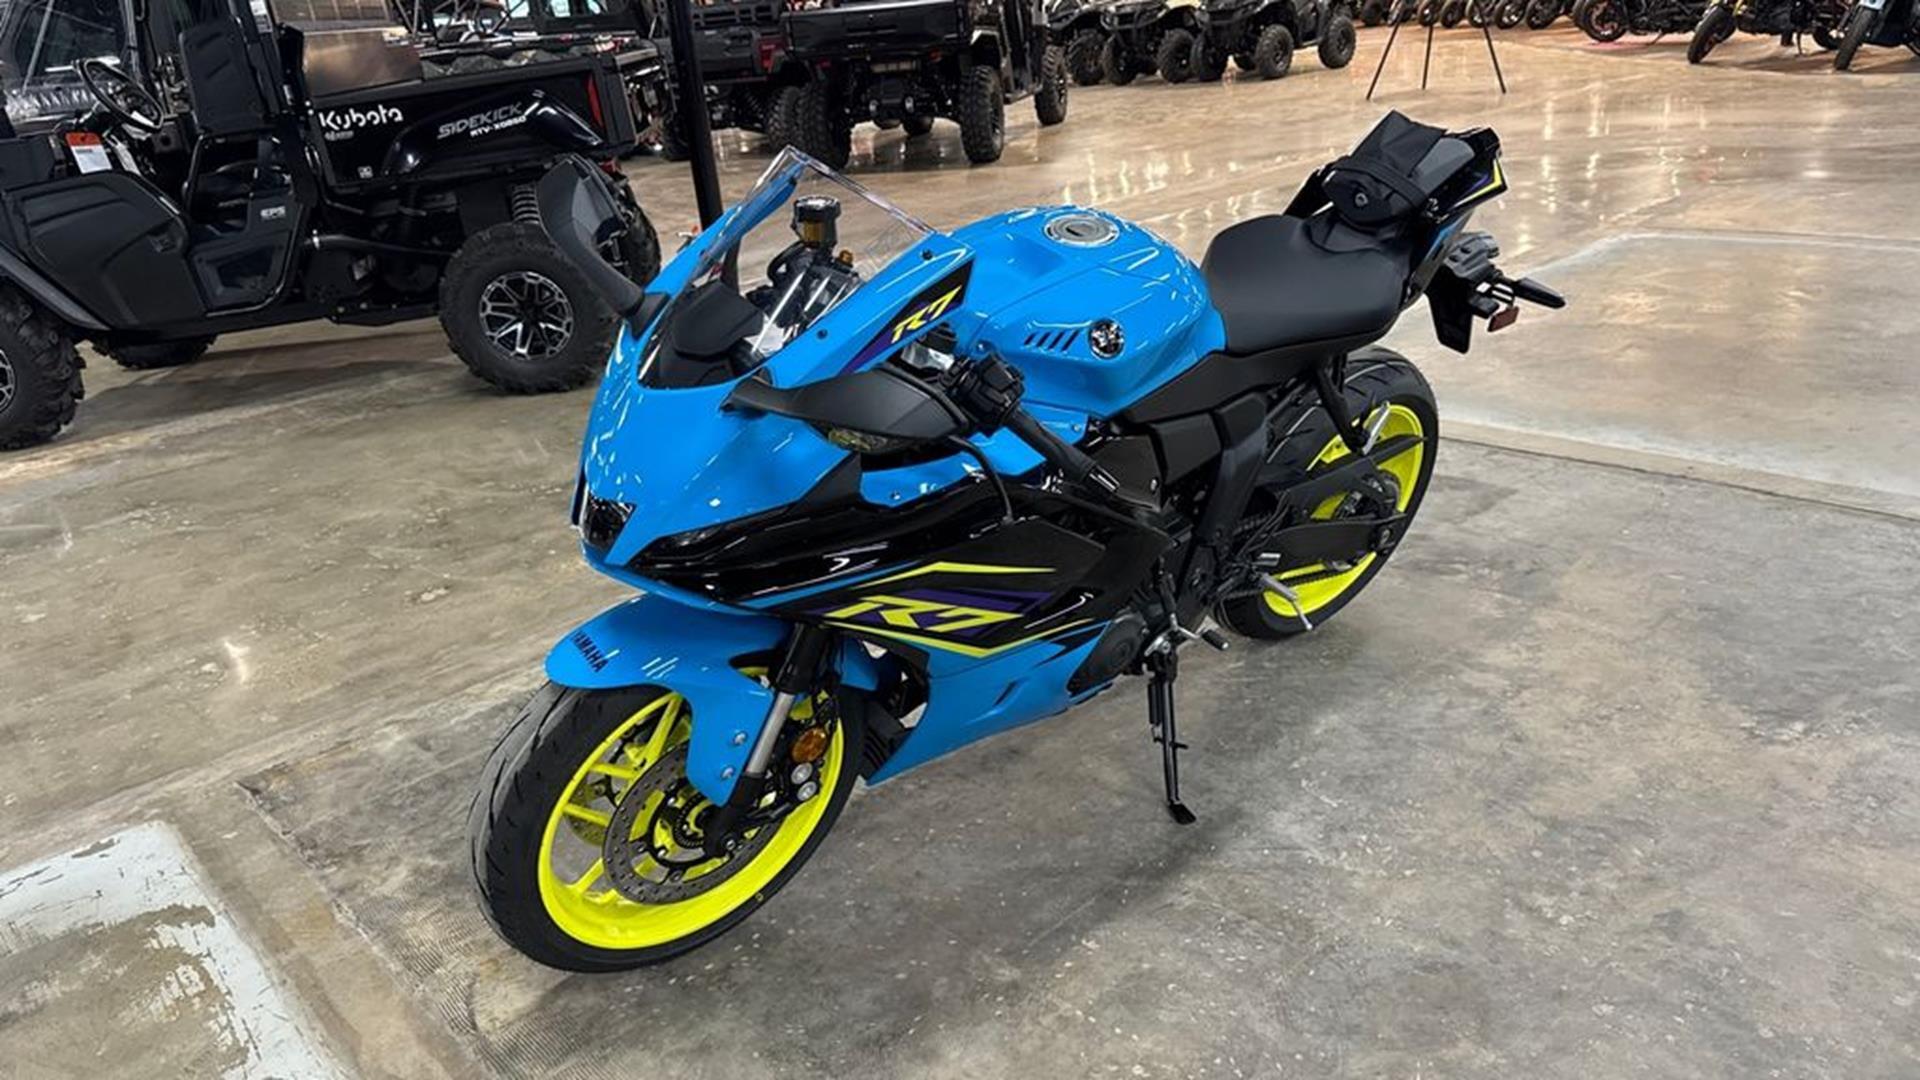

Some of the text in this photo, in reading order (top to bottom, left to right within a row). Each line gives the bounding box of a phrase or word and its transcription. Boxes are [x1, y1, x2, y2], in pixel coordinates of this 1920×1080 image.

[318, 104, 404, 131] Kubota
[437, 102, 522, 139] SIDEKICK
[891, 284, 962, 344] R7
[823, 595, 1024, 633] R7
[572, 630, 609, 673] YAMAHA
